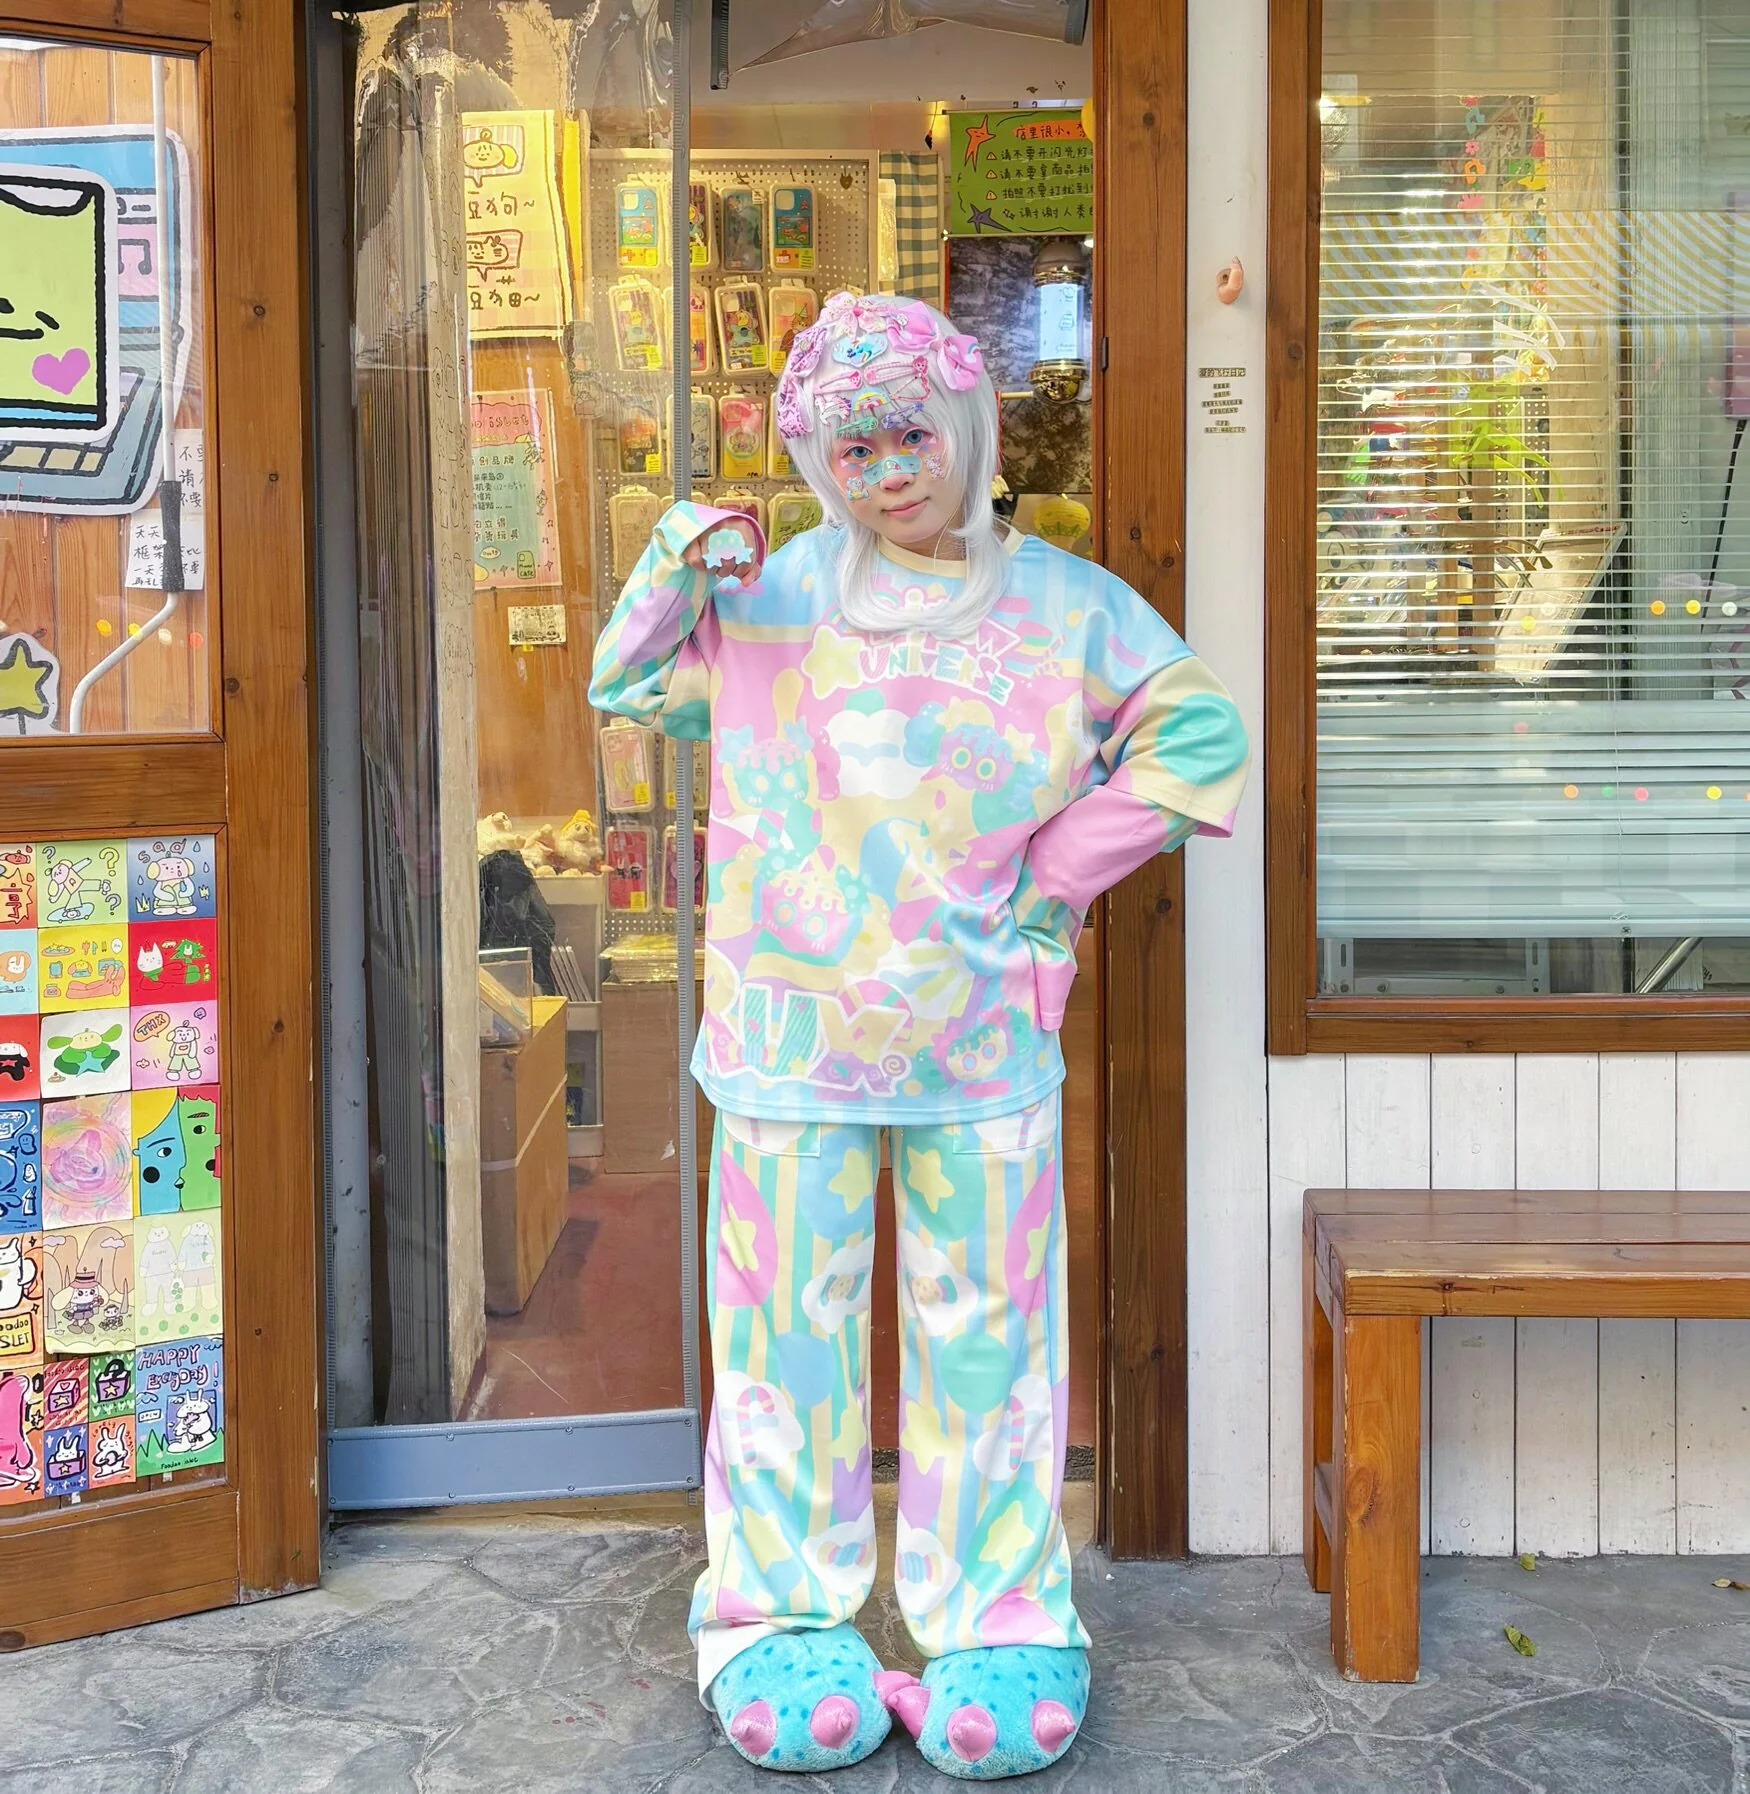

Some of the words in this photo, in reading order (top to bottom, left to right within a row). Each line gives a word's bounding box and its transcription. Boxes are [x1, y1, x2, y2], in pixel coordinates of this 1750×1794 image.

[1001, 146, 1093, 161] 请不要开闪光灯
[1000, 162, 1093, 181] 请不要拿商品拍
[1003, 183, 1093, 199] 拍照不要打扰到
[137, 1013, 166, 1036] THX
[137, 1344, 200, 1371] HAPPY
